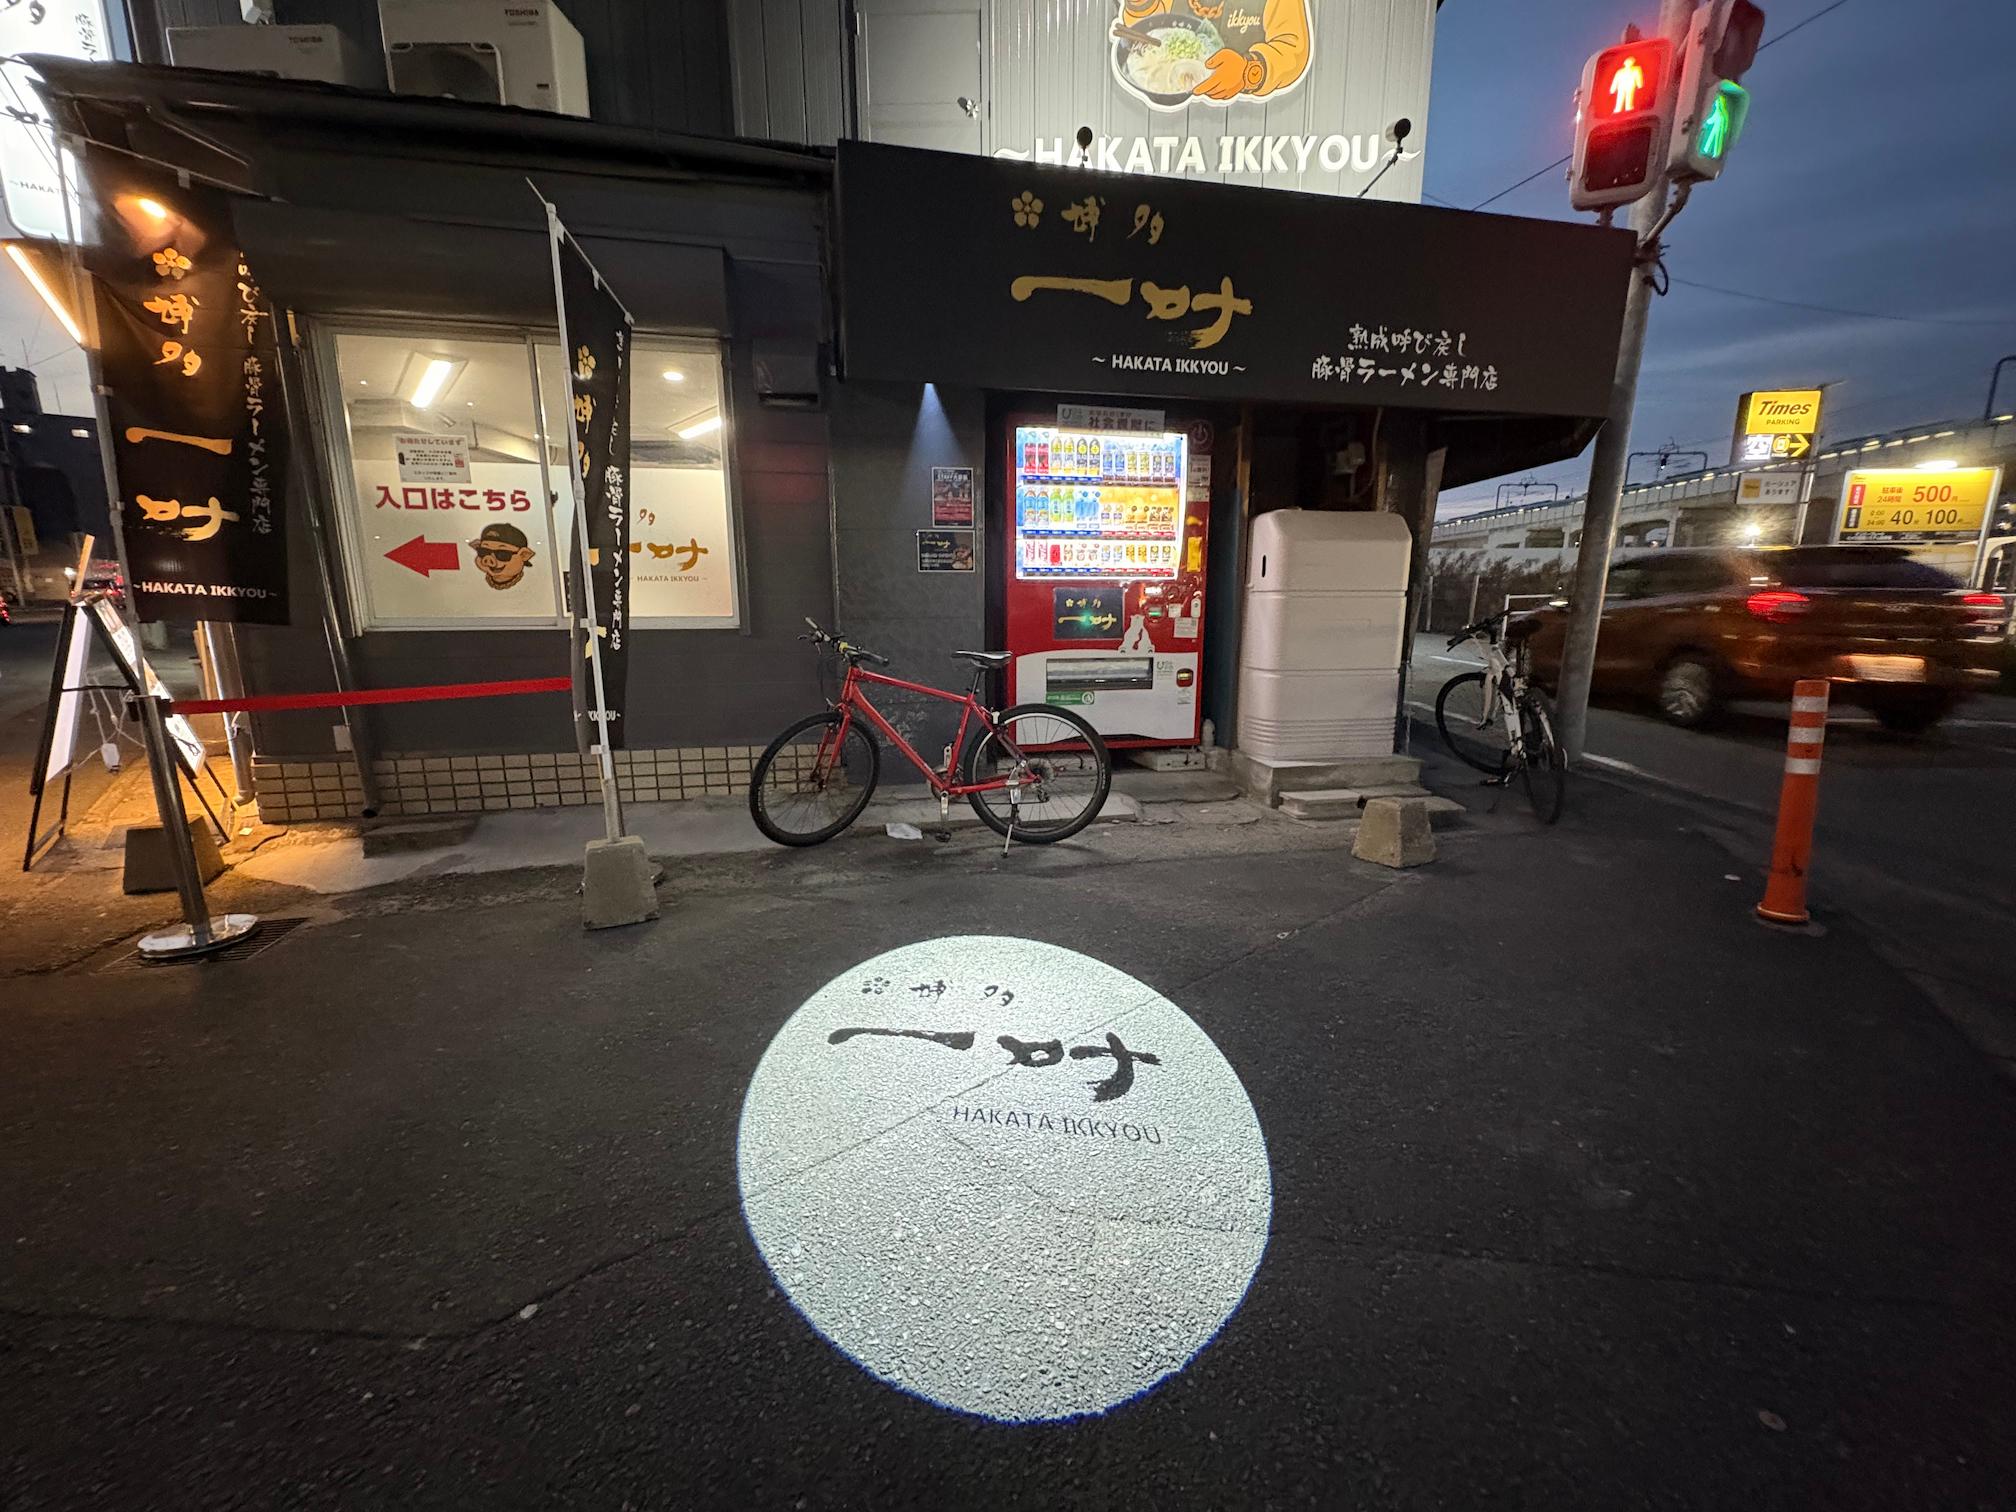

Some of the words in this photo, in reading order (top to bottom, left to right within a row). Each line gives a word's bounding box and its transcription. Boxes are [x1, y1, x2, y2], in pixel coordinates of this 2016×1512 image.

[1227, 9, 1261, 33] ikkyou
[1034, 135, 1206, 173] HAKATA
[1218, 134, 1380, 173] IKKYOU
[20, 181, 67, 195] HAKAT
[1347, 323, 1467, 356] 熟成呼び戻し
[1111, 353, 1172, 373] HAKATA
[1175, 355, 1229, 376] IKKYOU
[1311, 356, 1499, 391] 豚骨ラーメン専門店
[1759, 401, 1812, 415] Times
[375, 486, 531, 512] 入口はこちら
[1912, 485, 1952, 503] 500
[1890, 510, 1914, 525] 40
[1926, 509, 1958, 525] 100
[142, 582, 207, 596] HAKATA
[210, 585, 267, 598] IKKYOU
[953, 1104, 1056, 1132] HAKATA
[1062, 1116, 1163, 1145] IKKYOU
